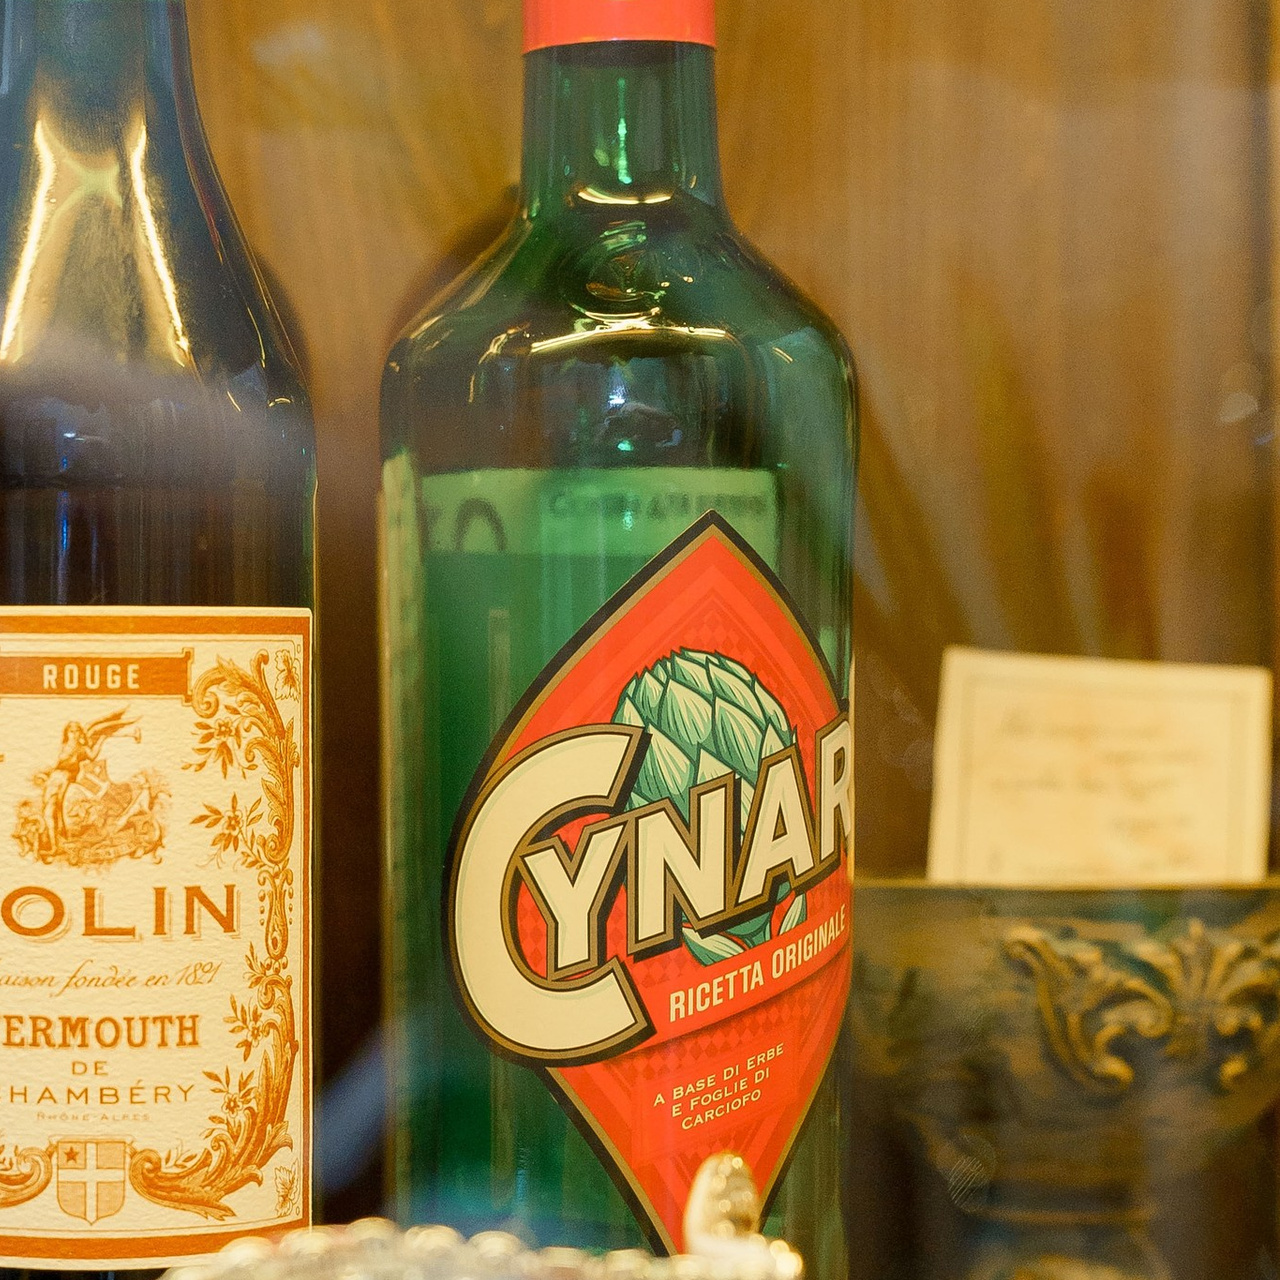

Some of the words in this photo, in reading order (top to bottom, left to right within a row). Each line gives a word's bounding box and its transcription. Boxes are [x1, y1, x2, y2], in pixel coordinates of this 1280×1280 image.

[42, 663, 141, 690] ROUGE
[444, 715, 854, 1064] CYNAR
[49, 960, 137, 998] fondée
[144, 974, 169, 986] en
[669, 960, 765, 1023] RICETTA
[771, 903, 846, 980] ORIGINALE
[72, 1060, 108, 1076] DE
[653, 1093, 665, 1107] A
[672, 1074, 716, 1100] BASE
[723, 1065, 739, 1081] DI
[746, 1042, 784, 1070] ERBE
[672, 1104, 682, 1117] E
[690, 1078, 748, 1111] FOGLIE
[754, 1067, 769, 1084] DI
[681, 1089, 761, 1130] CARCIOFO
